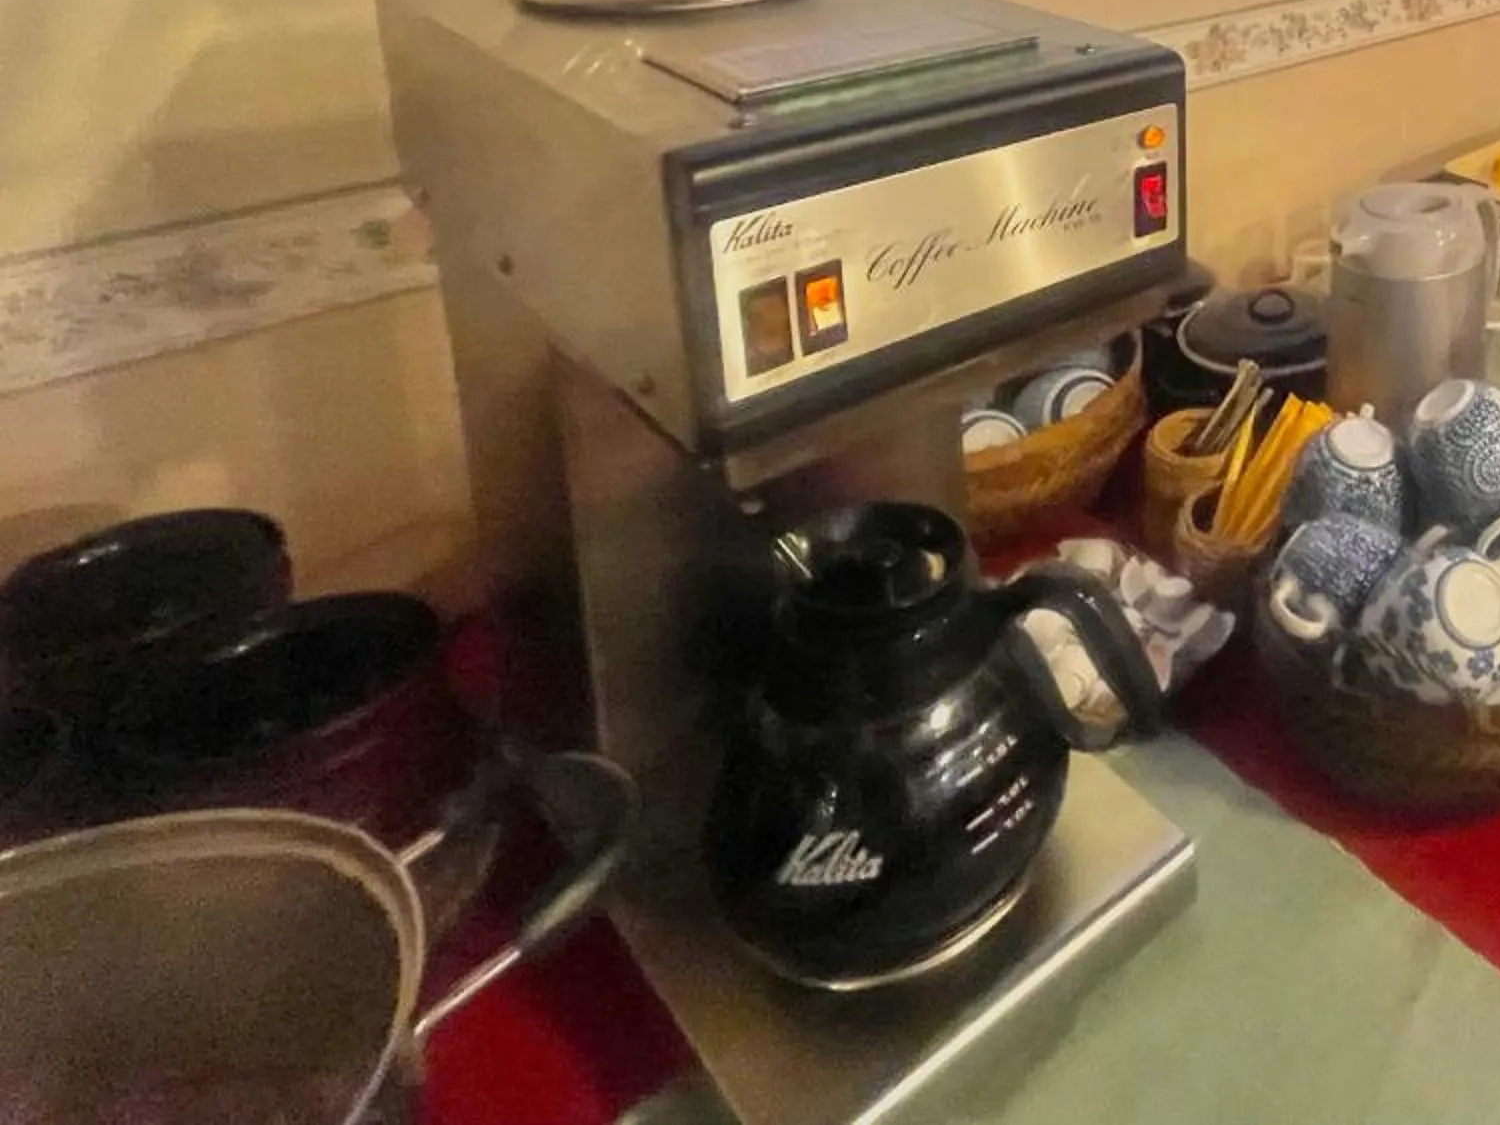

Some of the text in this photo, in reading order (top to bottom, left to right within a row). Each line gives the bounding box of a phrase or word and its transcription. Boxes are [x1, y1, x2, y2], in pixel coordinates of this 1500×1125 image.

[723, 212, 793, 254] Kalita
[865, 228, 962, 291] Coffee
[976, 195, 1100, 246] Machine
[777, 830, 885, 886] Kalita
